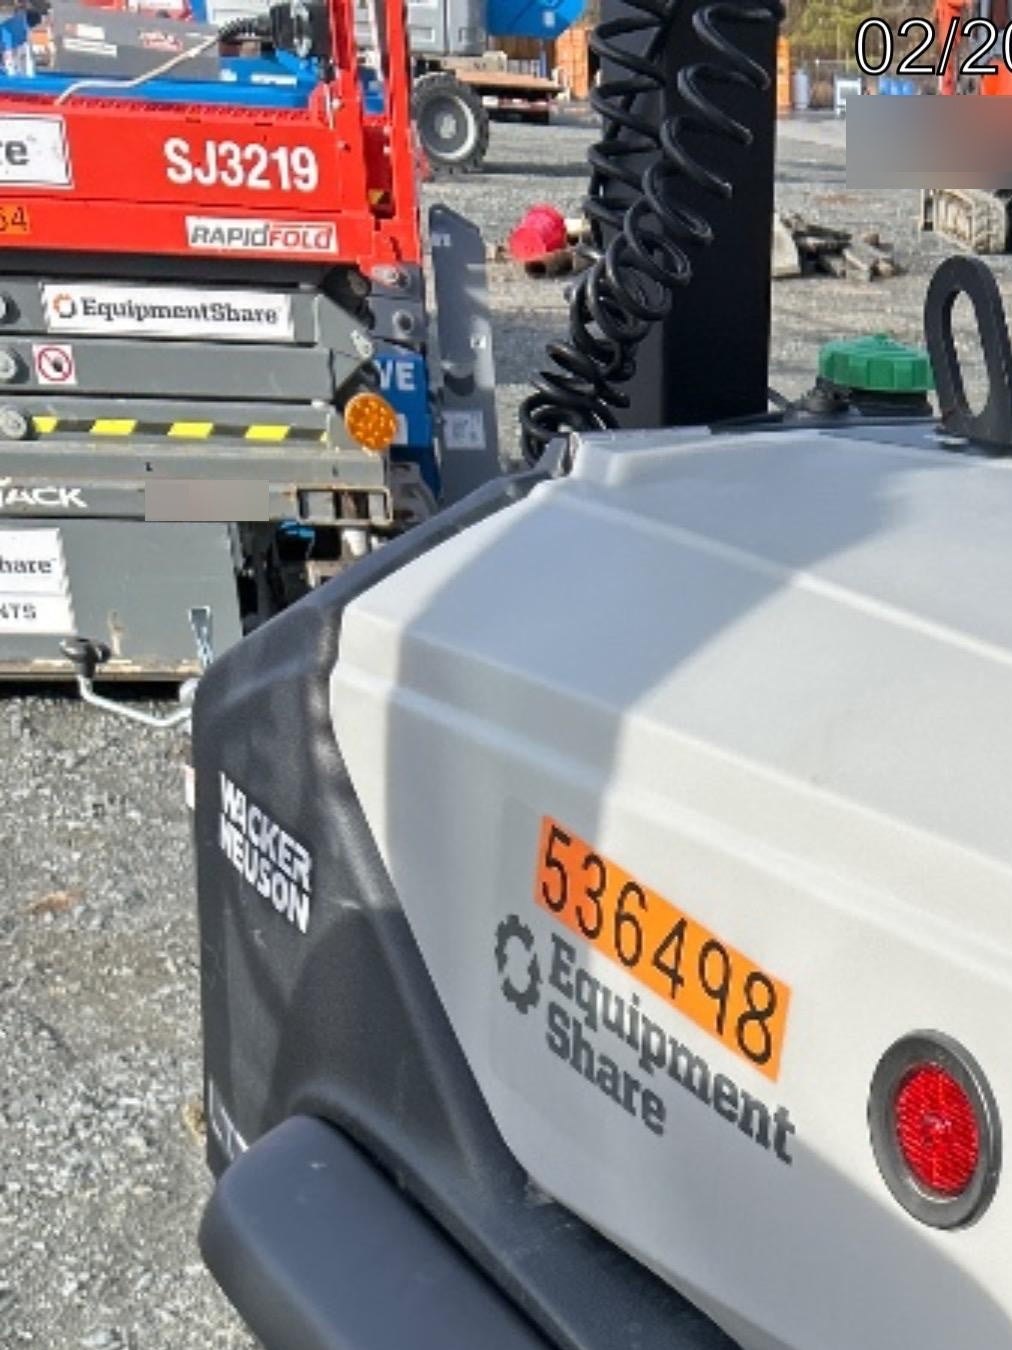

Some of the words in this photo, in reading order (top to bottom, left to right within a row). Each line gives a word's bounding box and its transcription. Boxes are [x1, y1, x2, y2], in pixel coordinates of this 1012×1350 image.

[164, 138, 319, 192] SJ3219
[80, 297, 278, 323] EquipmentShare
[218, 770, 312, 893] WACKER
[219, 812, 310, 934] NEUSON
[541, 825, 778, 1065] 536498
[545, 1002, 668, 1137] Share
[548, 932, 796, 1165] Equipment
